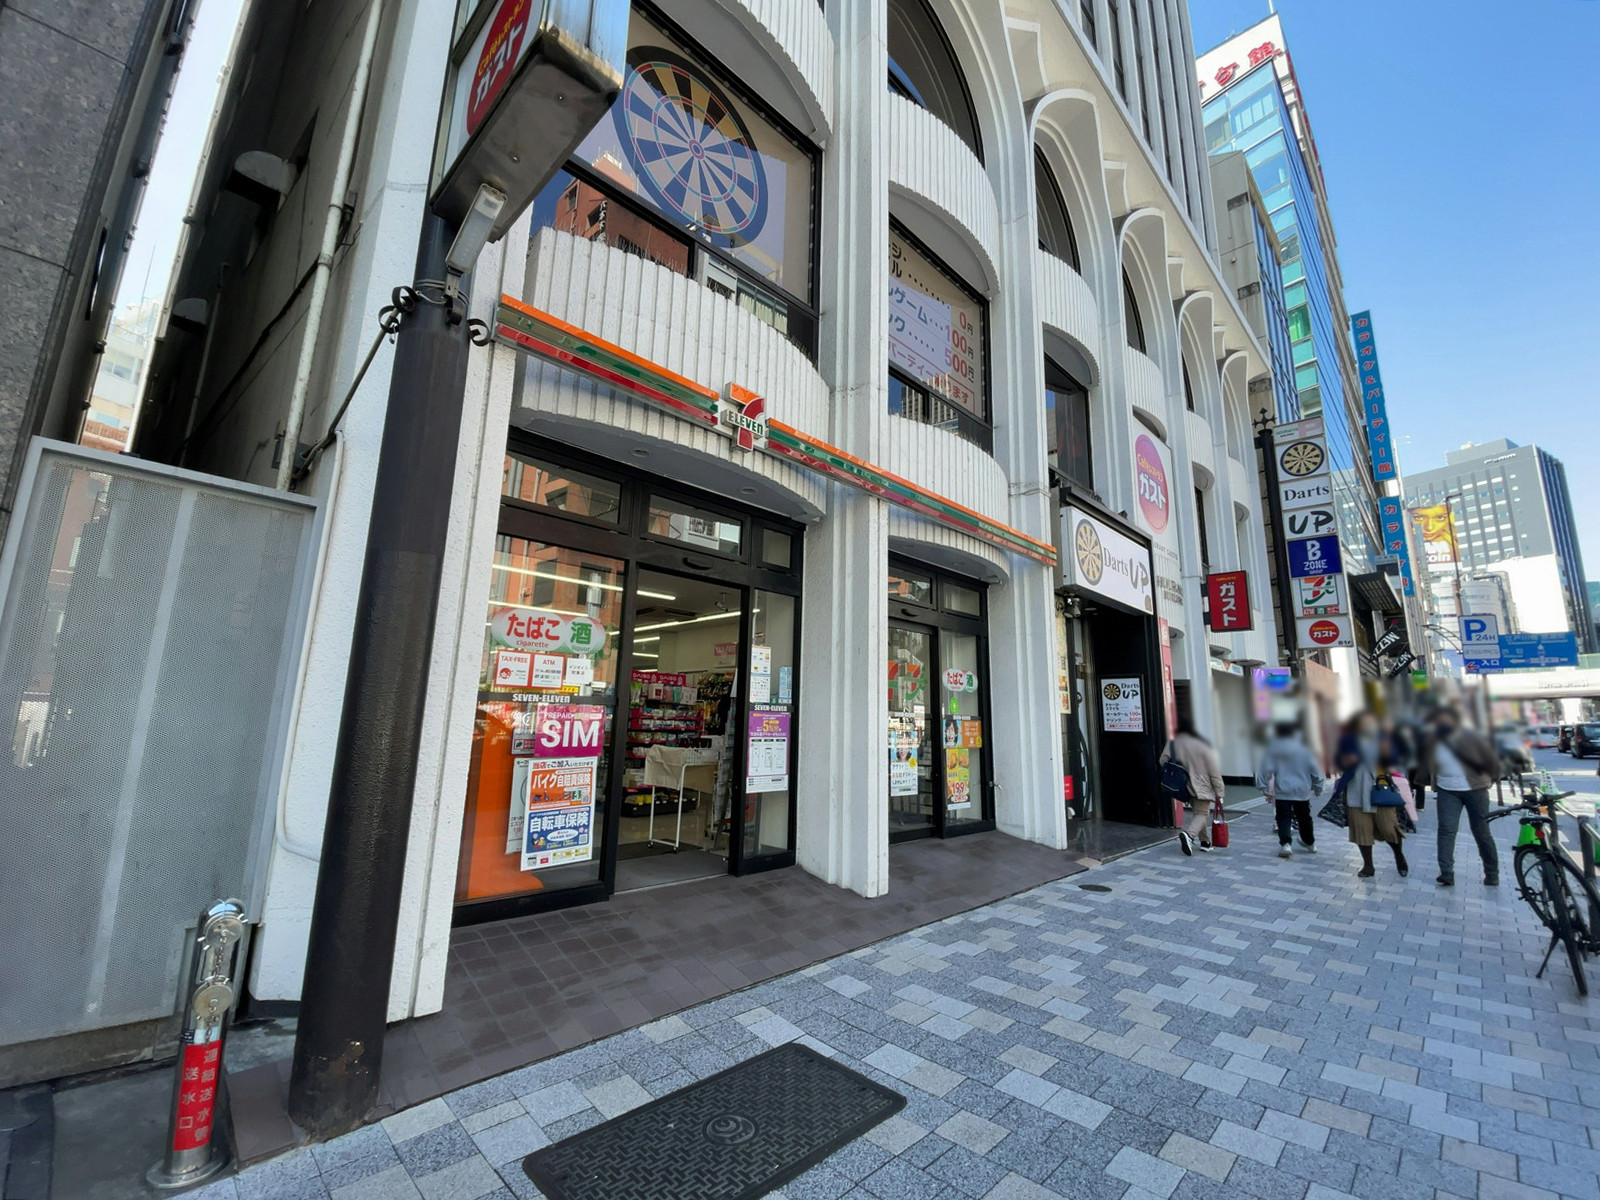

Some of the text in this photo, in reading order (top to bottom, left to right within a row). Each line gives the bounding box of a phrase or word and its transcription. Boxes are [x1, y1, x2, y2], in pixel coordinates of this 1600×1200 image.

[473, 22, 523, 113] ガスト
[1198, 41, 1283, 86] ケ館
[945, 324, 974, 360] 100円
[1139, 471, 1167, 509] ガスト
[1284, 485, 1330, 501] Darts
[1288, 510, 1334, 535] UP
[1103, 546, 1128, 577] Darts
[1129, 557, 1149, 594] UP
[1303, 559, 1328, 571] ZONE
[1218, 581, 1237, 627] ガスト
[505, 613, 593, 645] たばこ 酒
[1313, 630, 1337, 638] ガスト
[1463, 619, 1487, 642] P
[516, 639, 549, 649] cigarette
[500, 654, 529, 664] TAX-FREE
[1481, 659, 1500, 667] 入口
[946, 671, 974, 687] たばこ 酒
[1122, 689, 1139, 699] UP
[545, 711, 574, 720] PREPAID
[540, 719, 600, 748] SIM
[532, 772, 591, 789] バイク自賠責保険
[529, 811, 589, 833] 自転車保険
[179, 1067, 200, 1130] 送水口
[195, 1047, 219, 1142] 連結送水管
